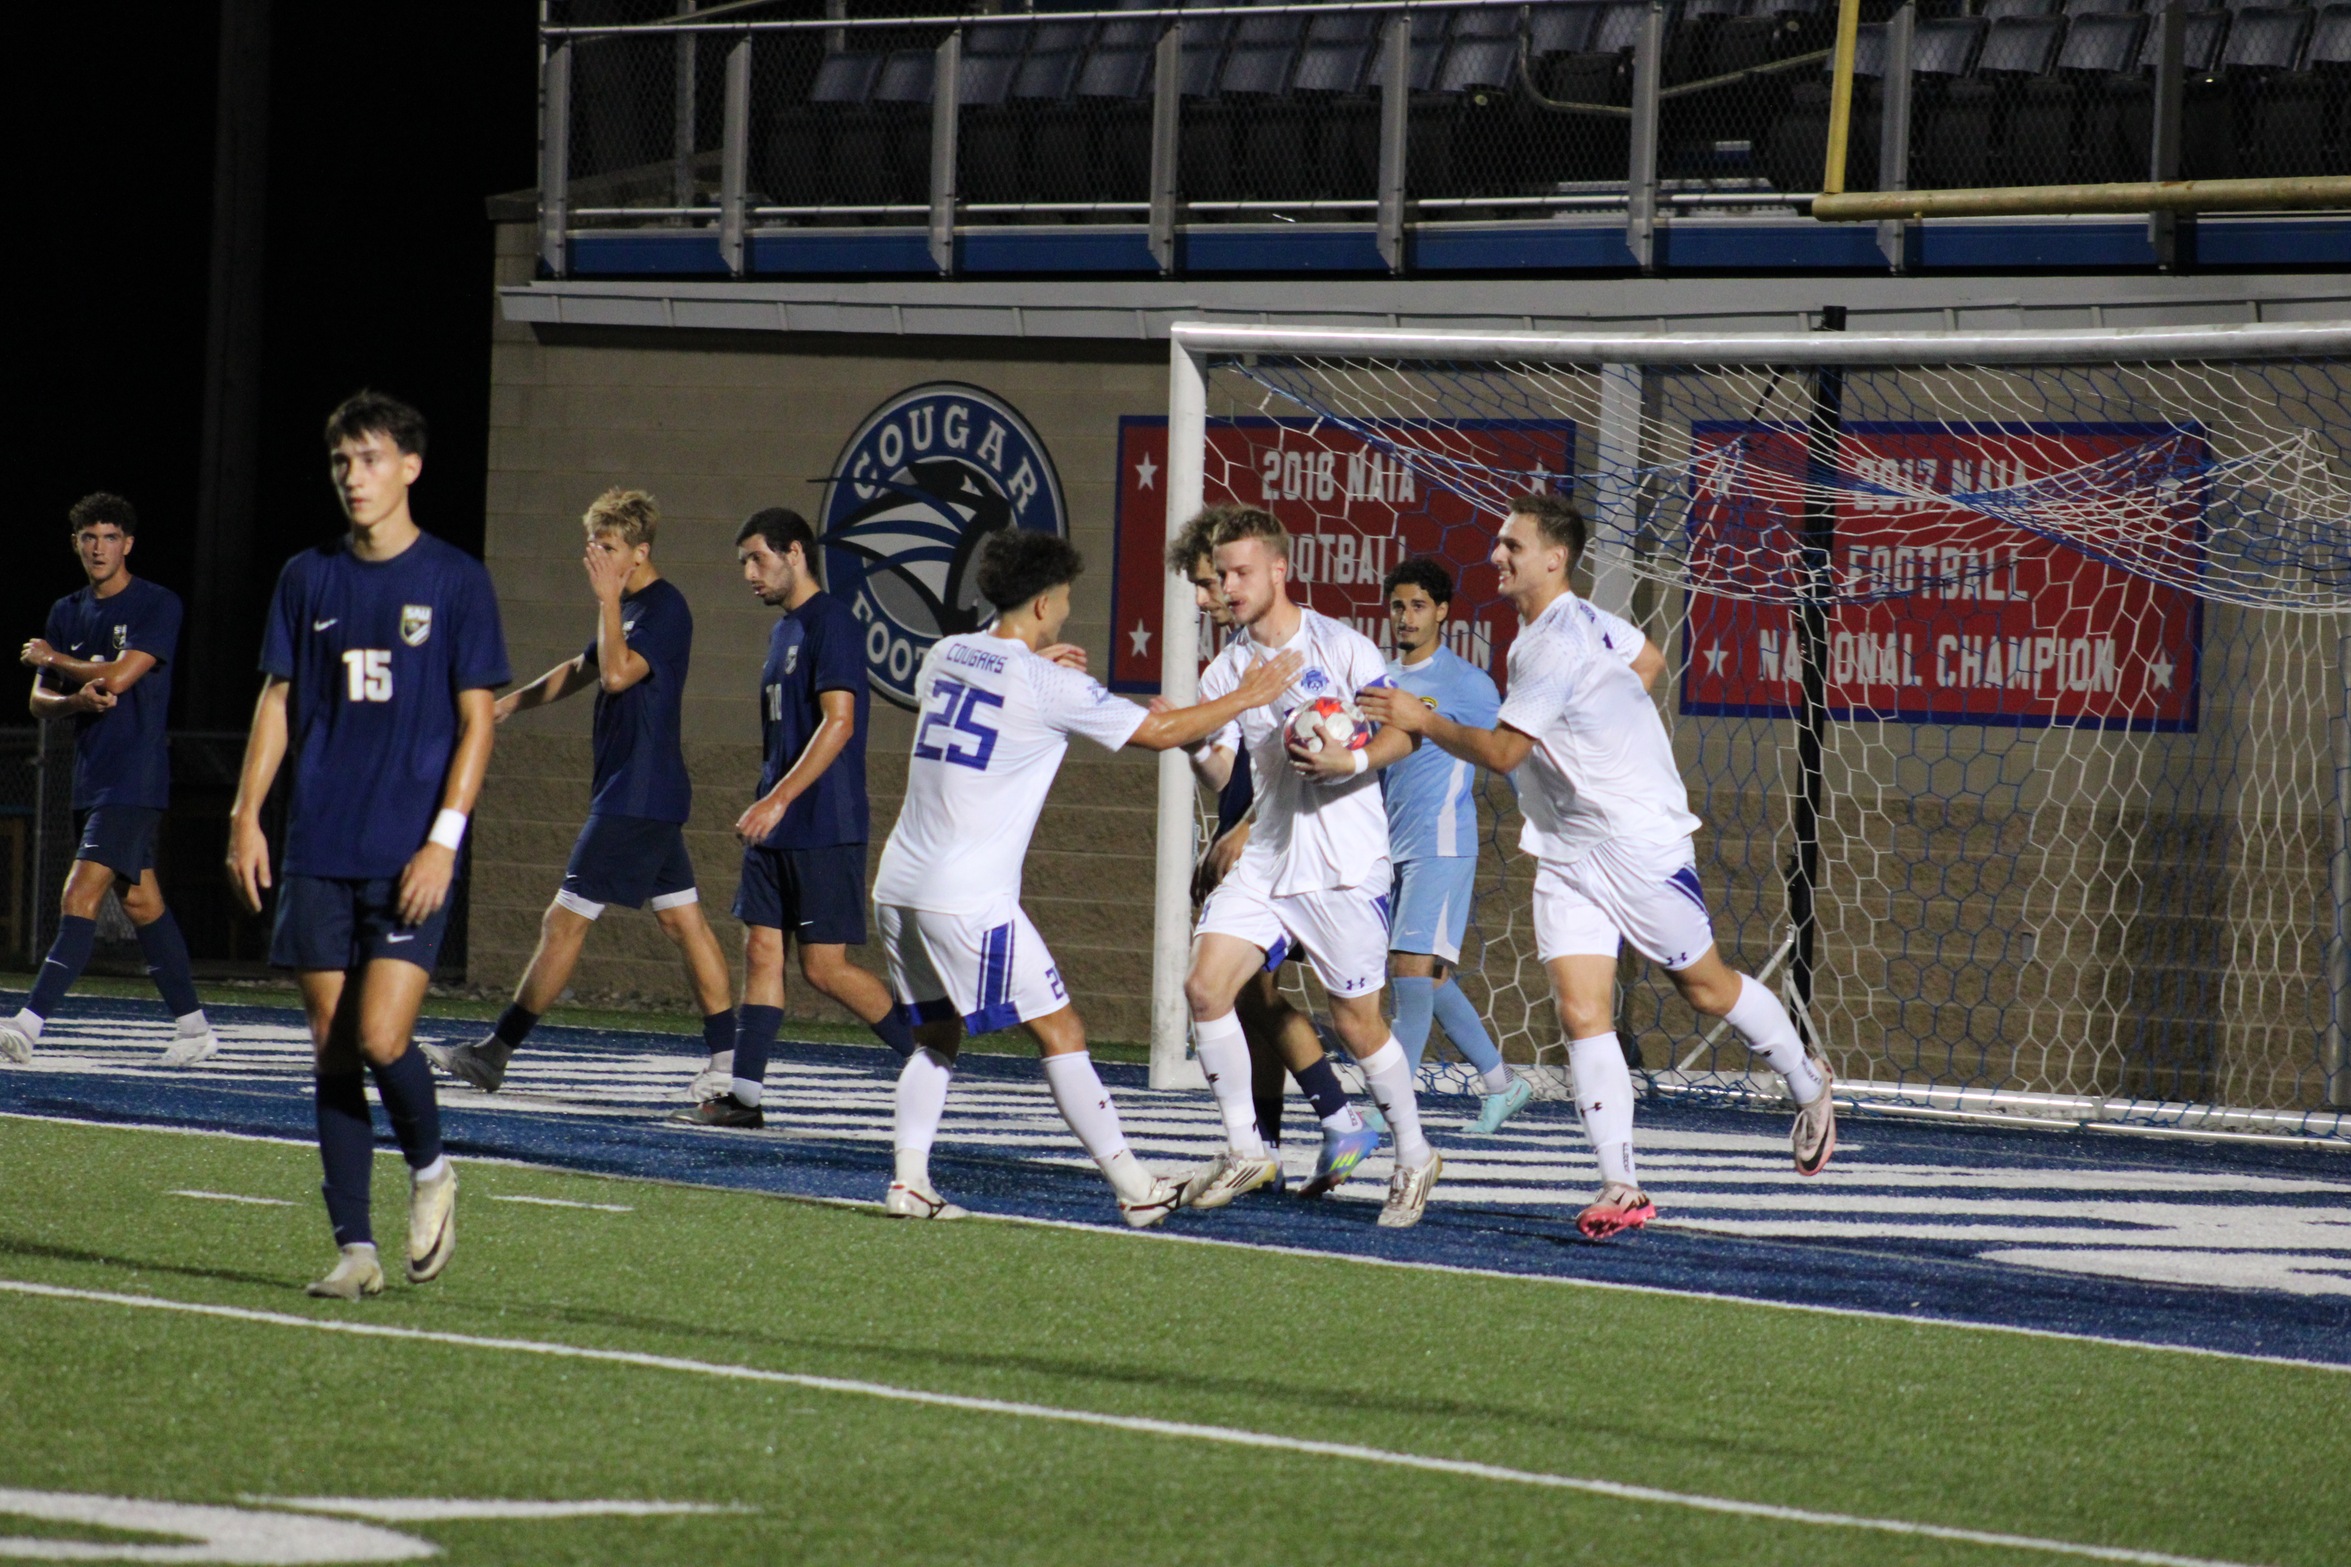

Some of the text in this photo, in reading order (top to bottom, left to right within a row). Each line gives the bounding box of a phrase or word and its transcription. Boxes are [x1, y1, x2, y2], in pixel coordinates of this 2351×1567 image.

[853, 404, 1038, 515] COUGAR
[1261, 451, 1416, 503] 2018 NAIA
[1853, 457, 1938, 512] 2017
[1847, 544, 2029, 602] FOOTBALL
[342, 649, 394, 702] 15
[946, 643, 1009, 674] COUGARS
[1758, 628, 2117, 693] NAIONAL CHAMPION
[913, 678, 1005, 772] 25
